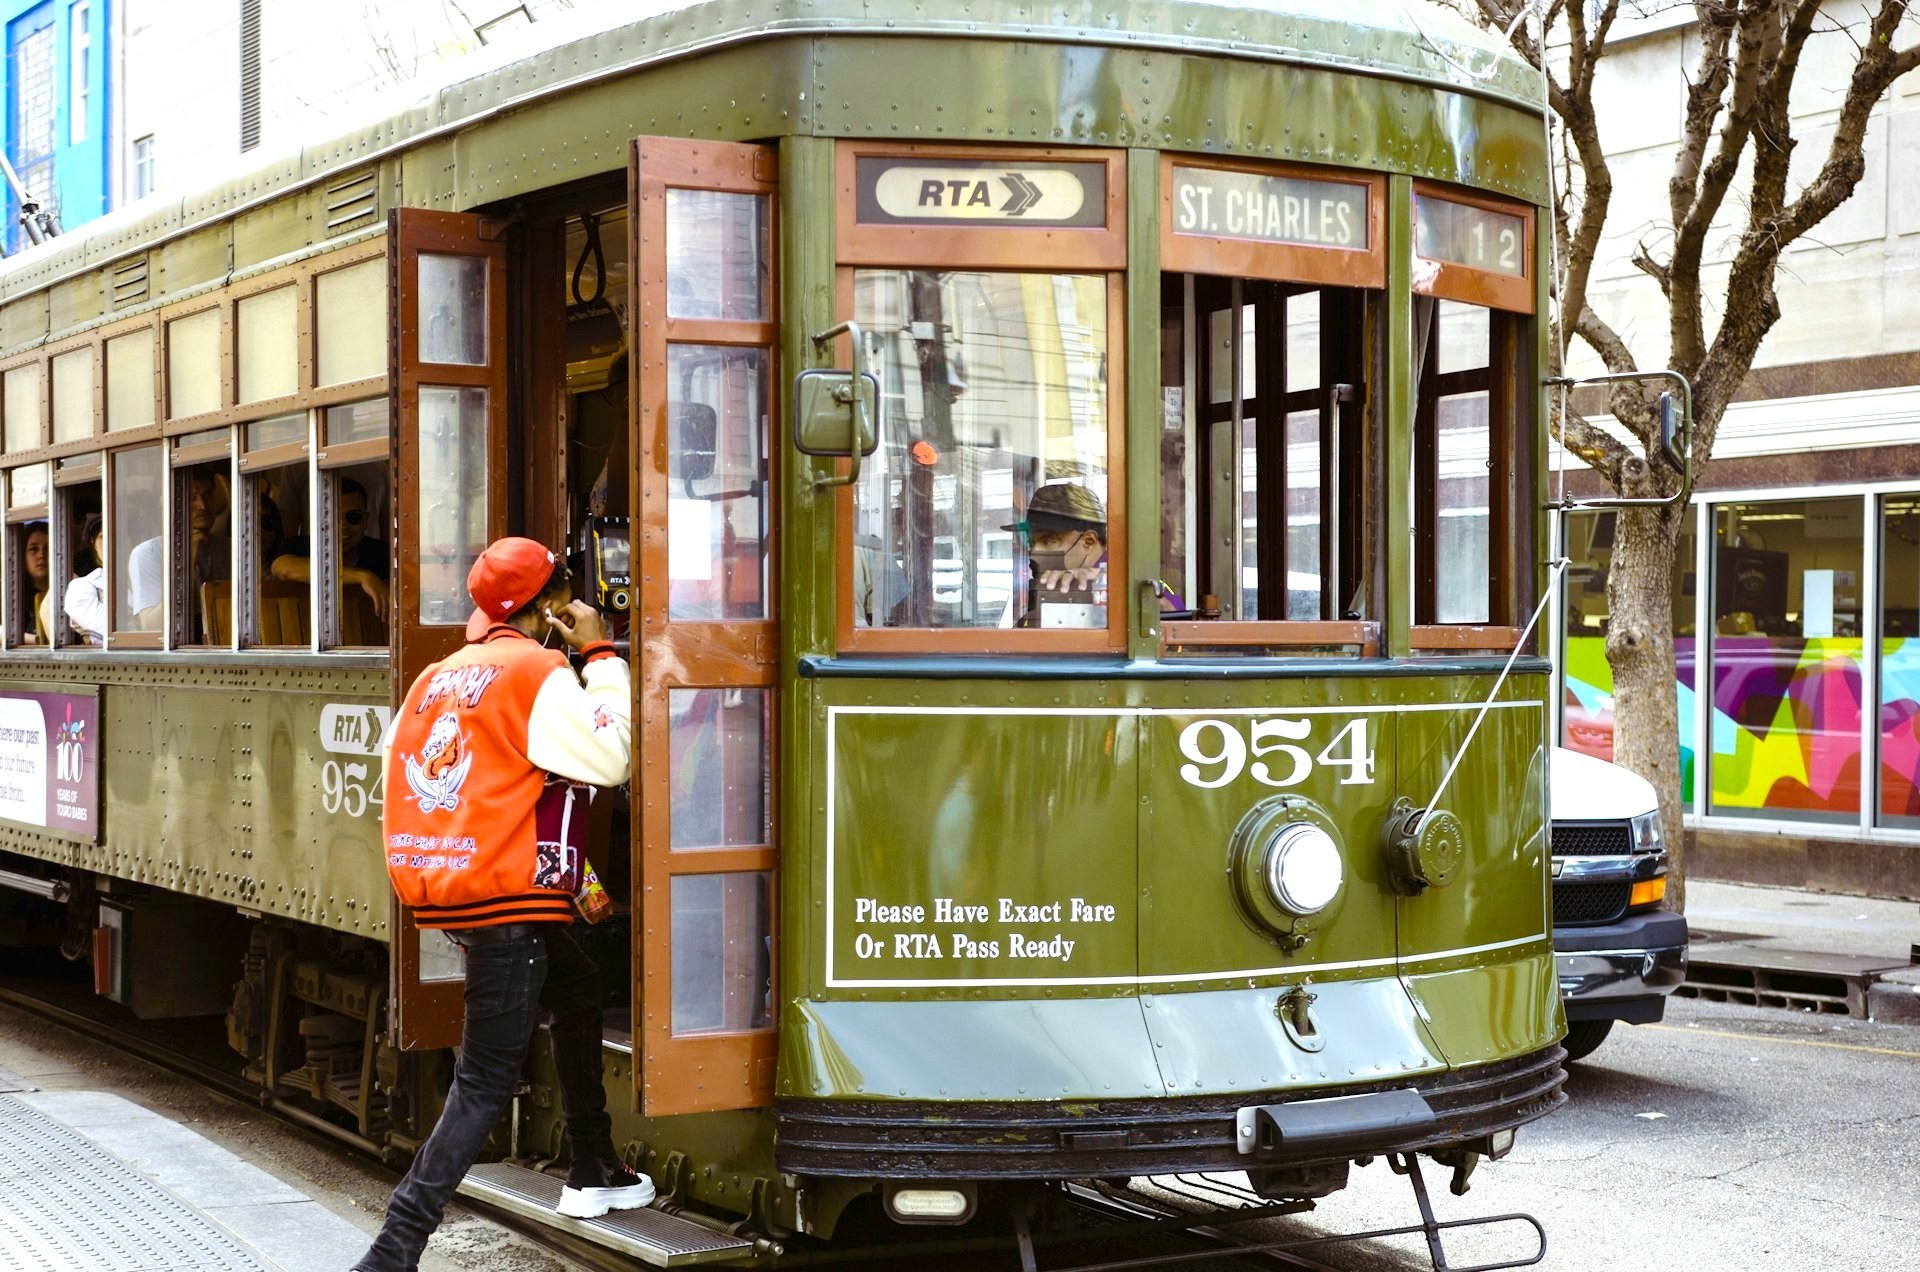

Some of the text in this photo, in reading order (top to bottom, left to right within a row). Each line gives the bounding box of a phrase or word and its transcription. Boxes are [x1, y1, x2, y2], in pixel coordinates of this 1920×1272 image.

[918, 180, 991, 207] RTA
[1179, 184, 1351, 245] ST. CHARLES
[333, 714, 362, 743] RTA
[56, 741, 84, 783] 100
[1179, 718, 1375, 788] 954
[855, 898, 1116, 923] Please Have Exact Fare
[855, 933, 1076, 962] Or RTA Pass Ready
